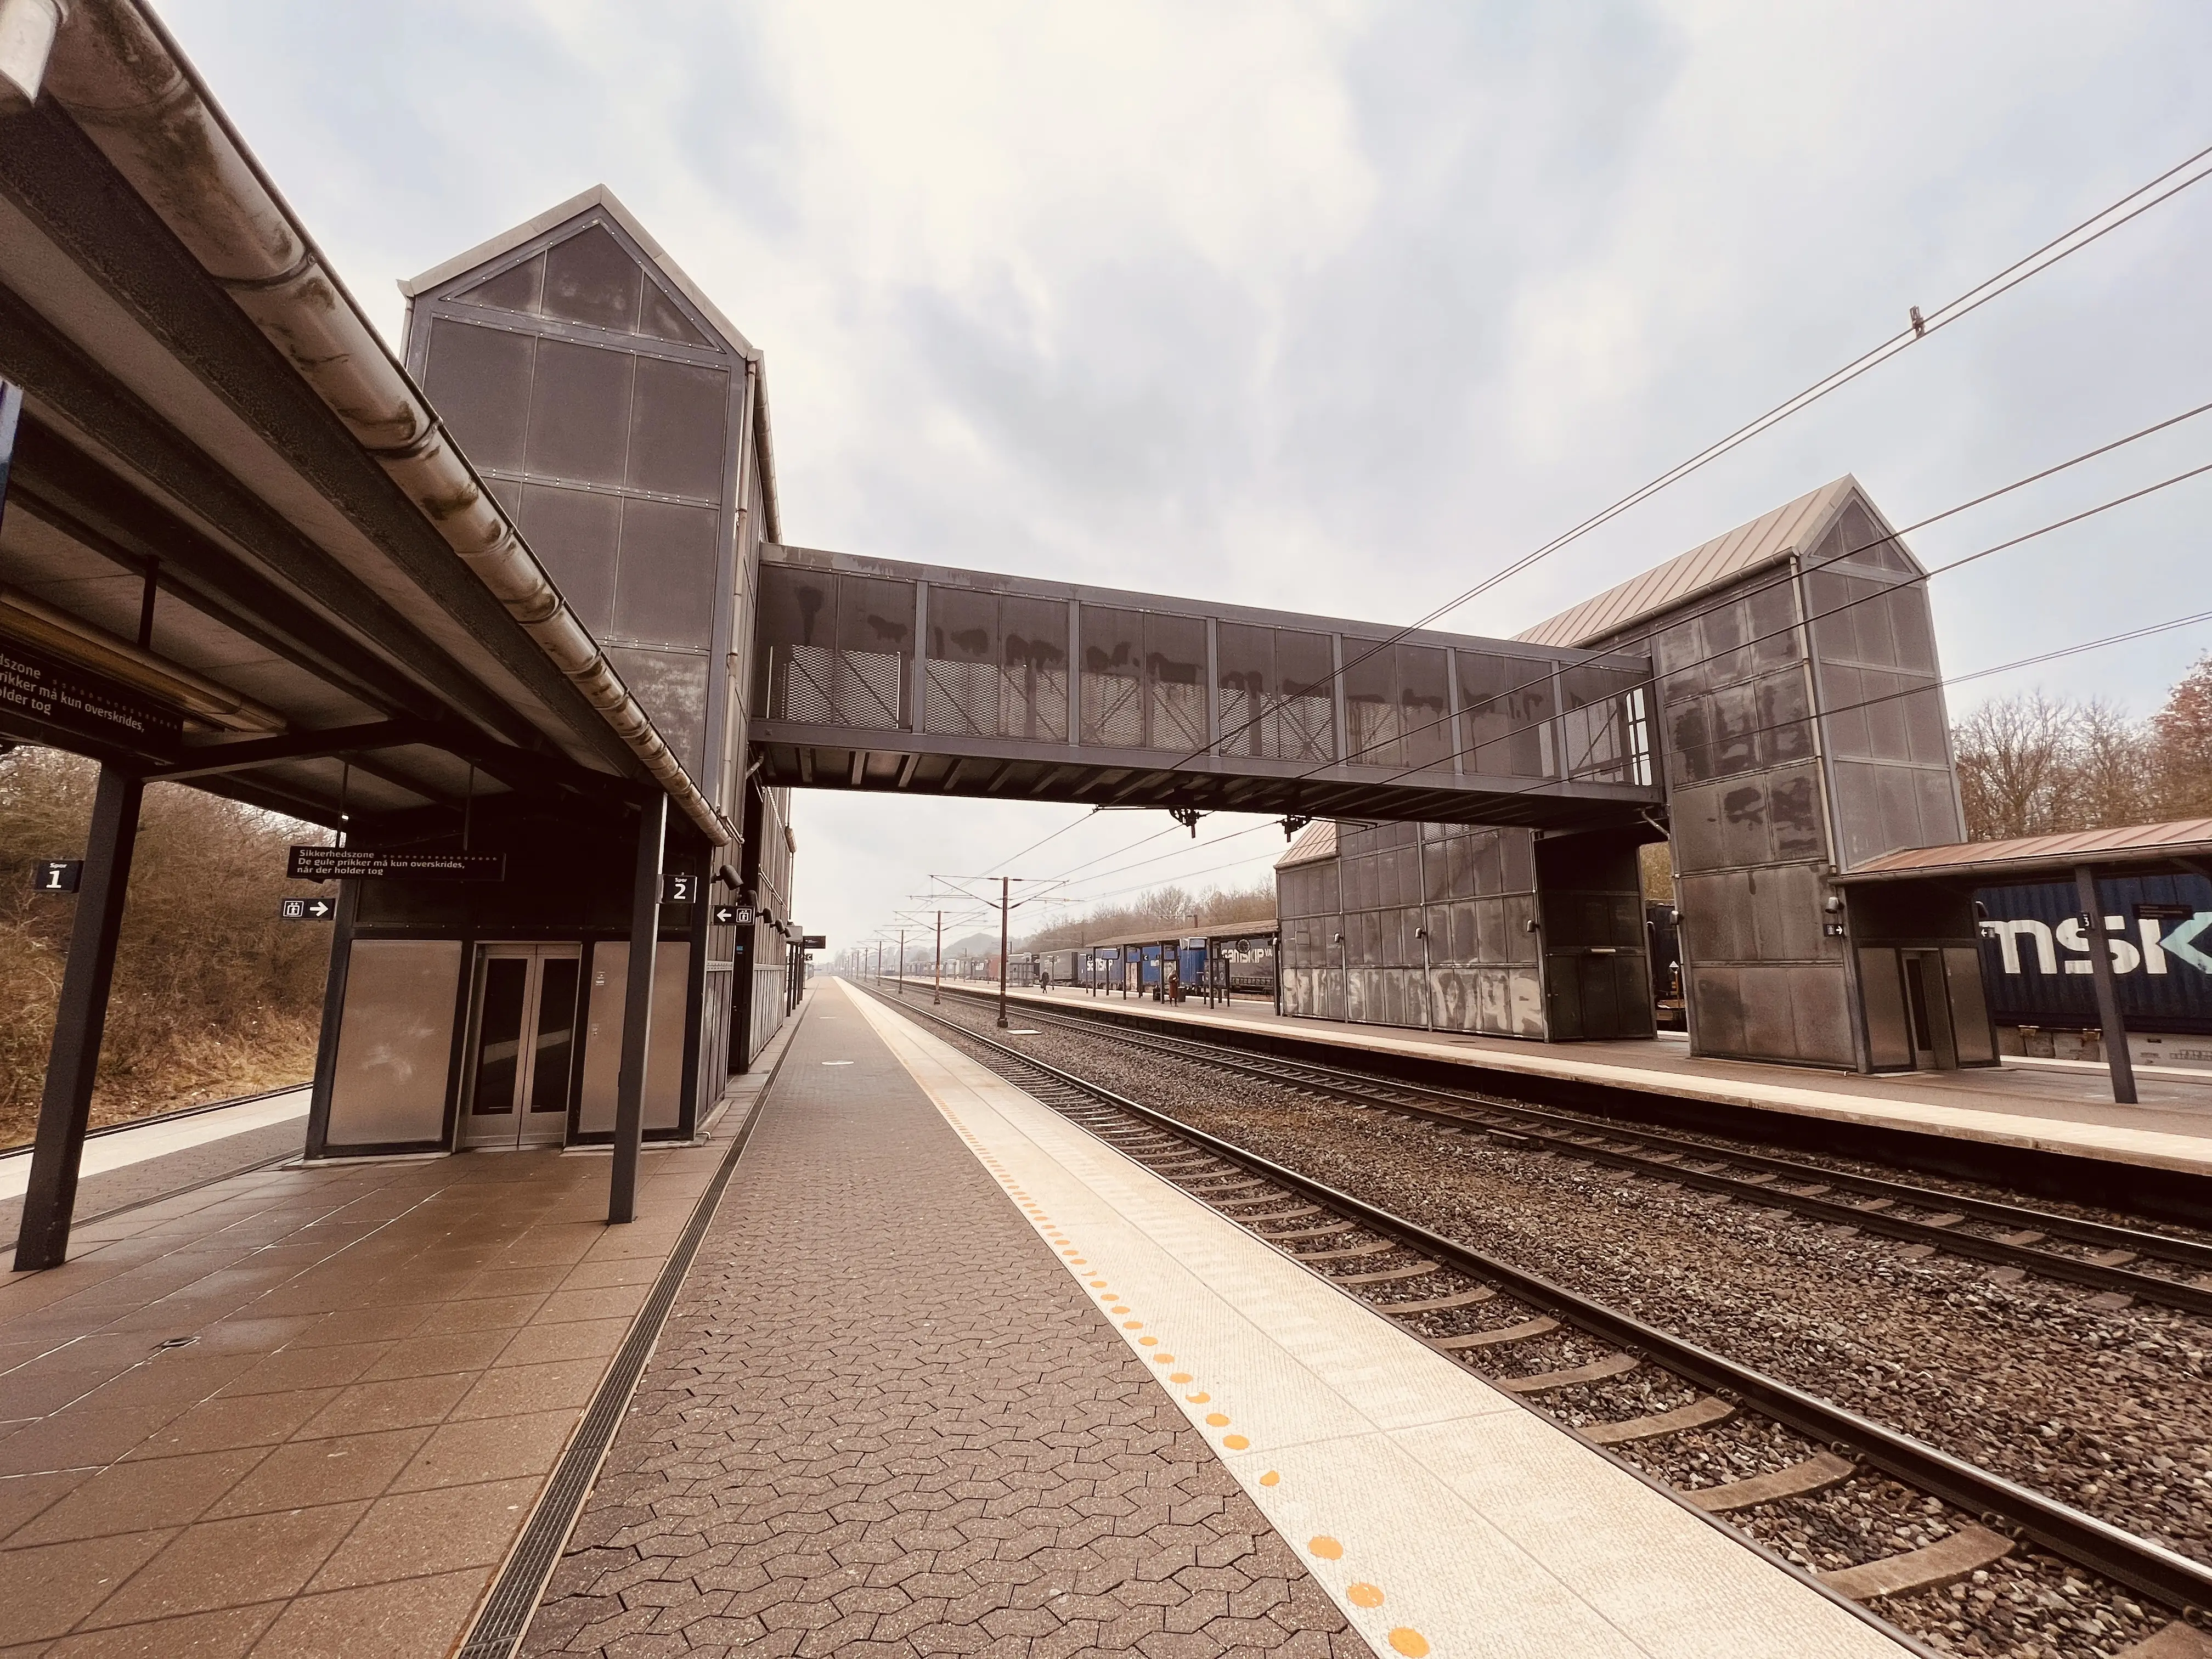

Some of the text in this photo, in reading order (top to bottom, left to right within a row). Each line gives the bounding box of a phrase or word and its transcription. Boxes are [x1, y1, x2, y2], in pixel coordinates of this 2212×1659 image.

[31, 698, 52, 716] tog
[39, 687, 58, 701] må
[61, 691, 82, 709] kun
[84, 703, 145, 733] overskrides,
[299, 849, 375, 858] Sikkerhedszone
[314, 858, 335, 866] gule
[337, 859, 371, 867] prikker
[410, 861, 465, 869] overskrides,
[46, 870, 61, 888] 1
[674, 883, 686, 899] 2
